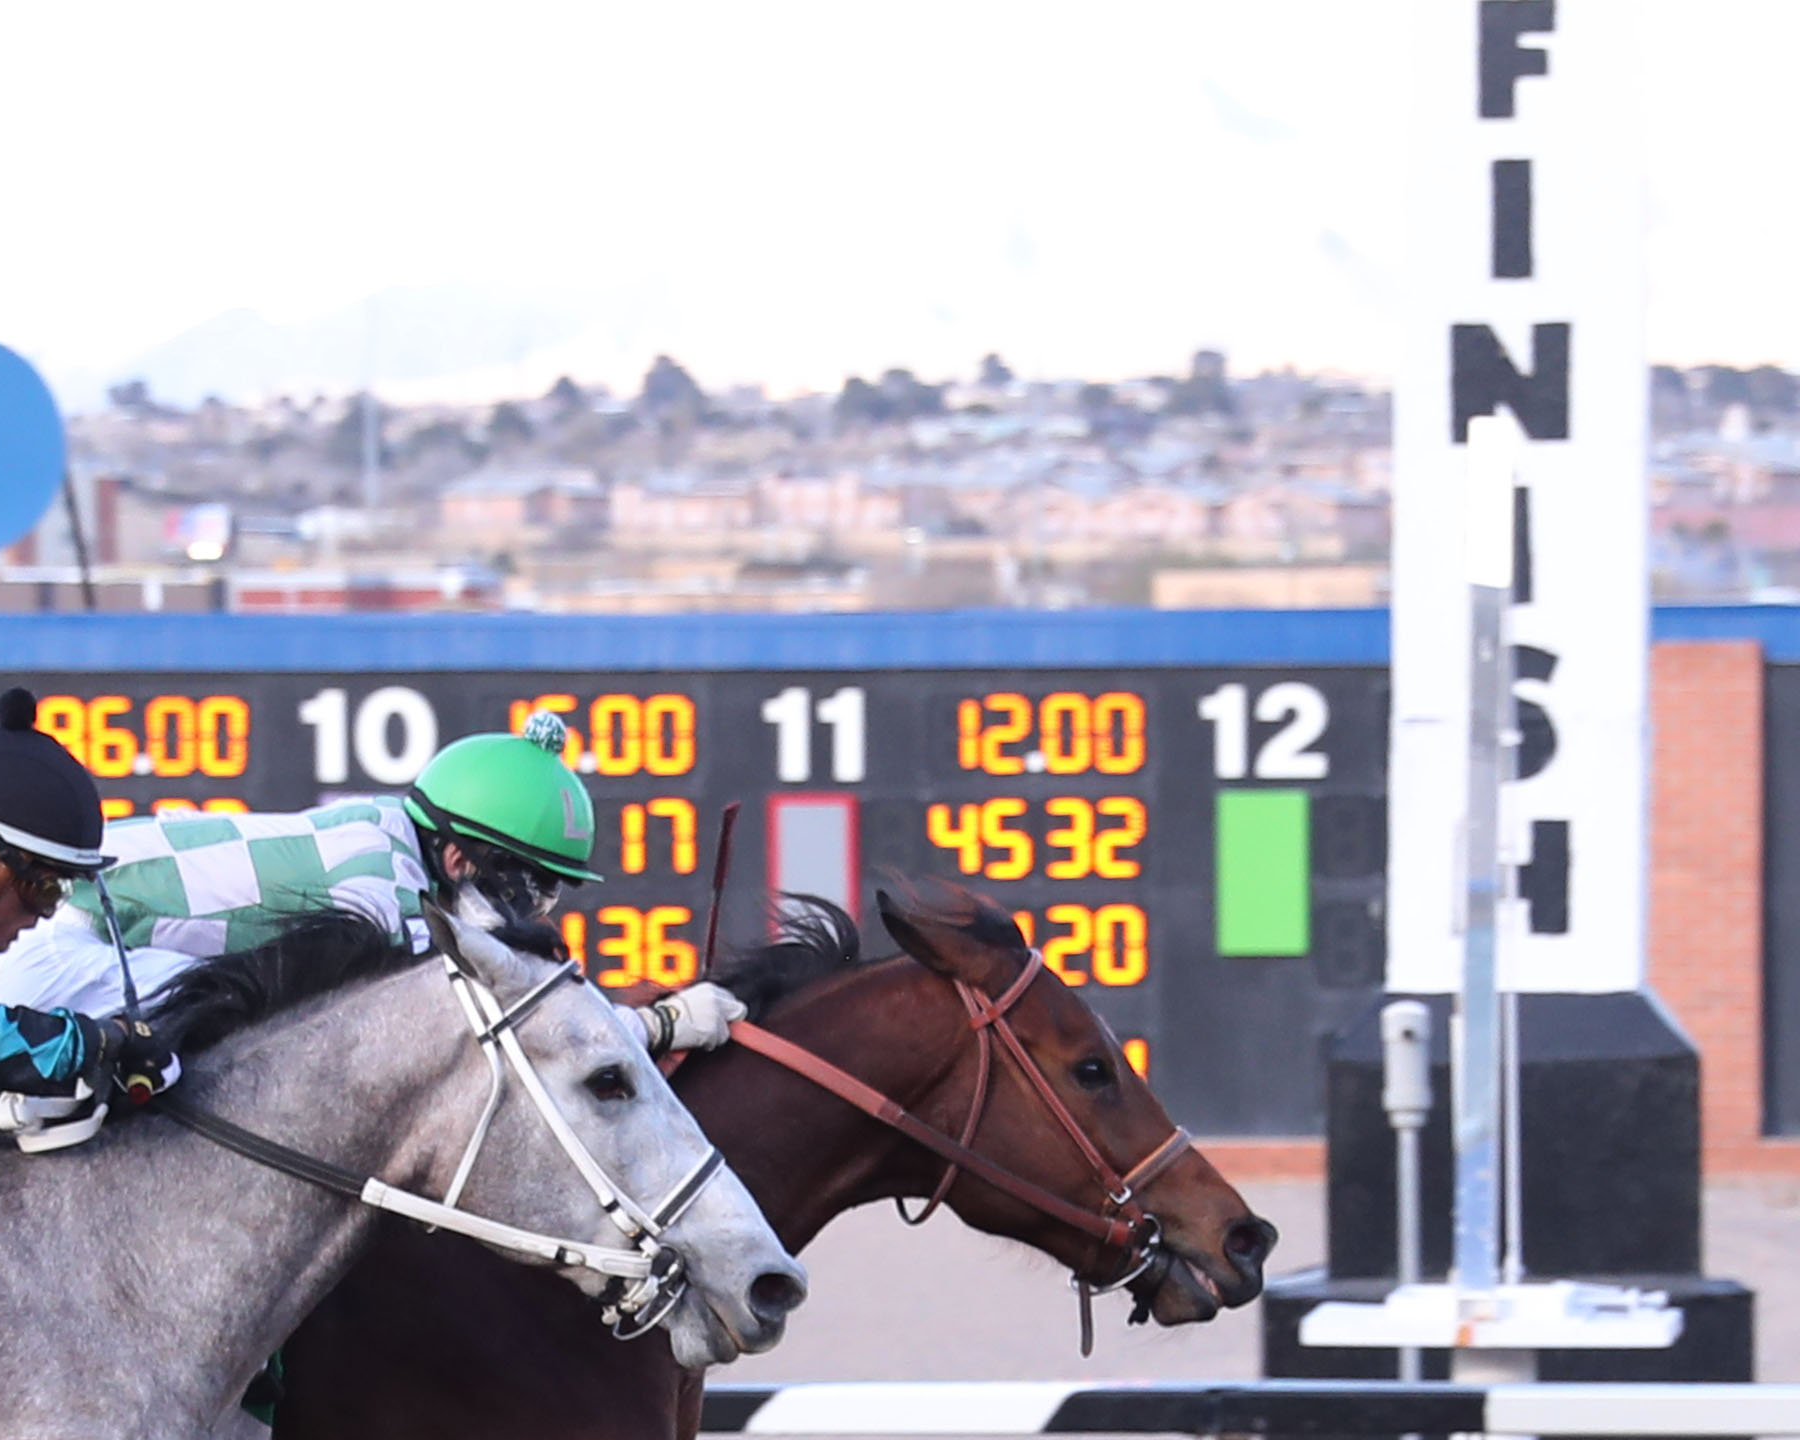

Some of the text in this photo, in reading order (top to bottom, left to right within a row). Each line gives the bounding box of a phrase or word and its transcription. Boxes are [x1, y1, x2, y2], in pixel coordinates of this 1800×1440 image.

[299, 687, 440, 785] 10
[763, 687, 865, 782] 11
[958, 692, 1147, 776] 12.00
[1199, 683, 1329, 780] 12
